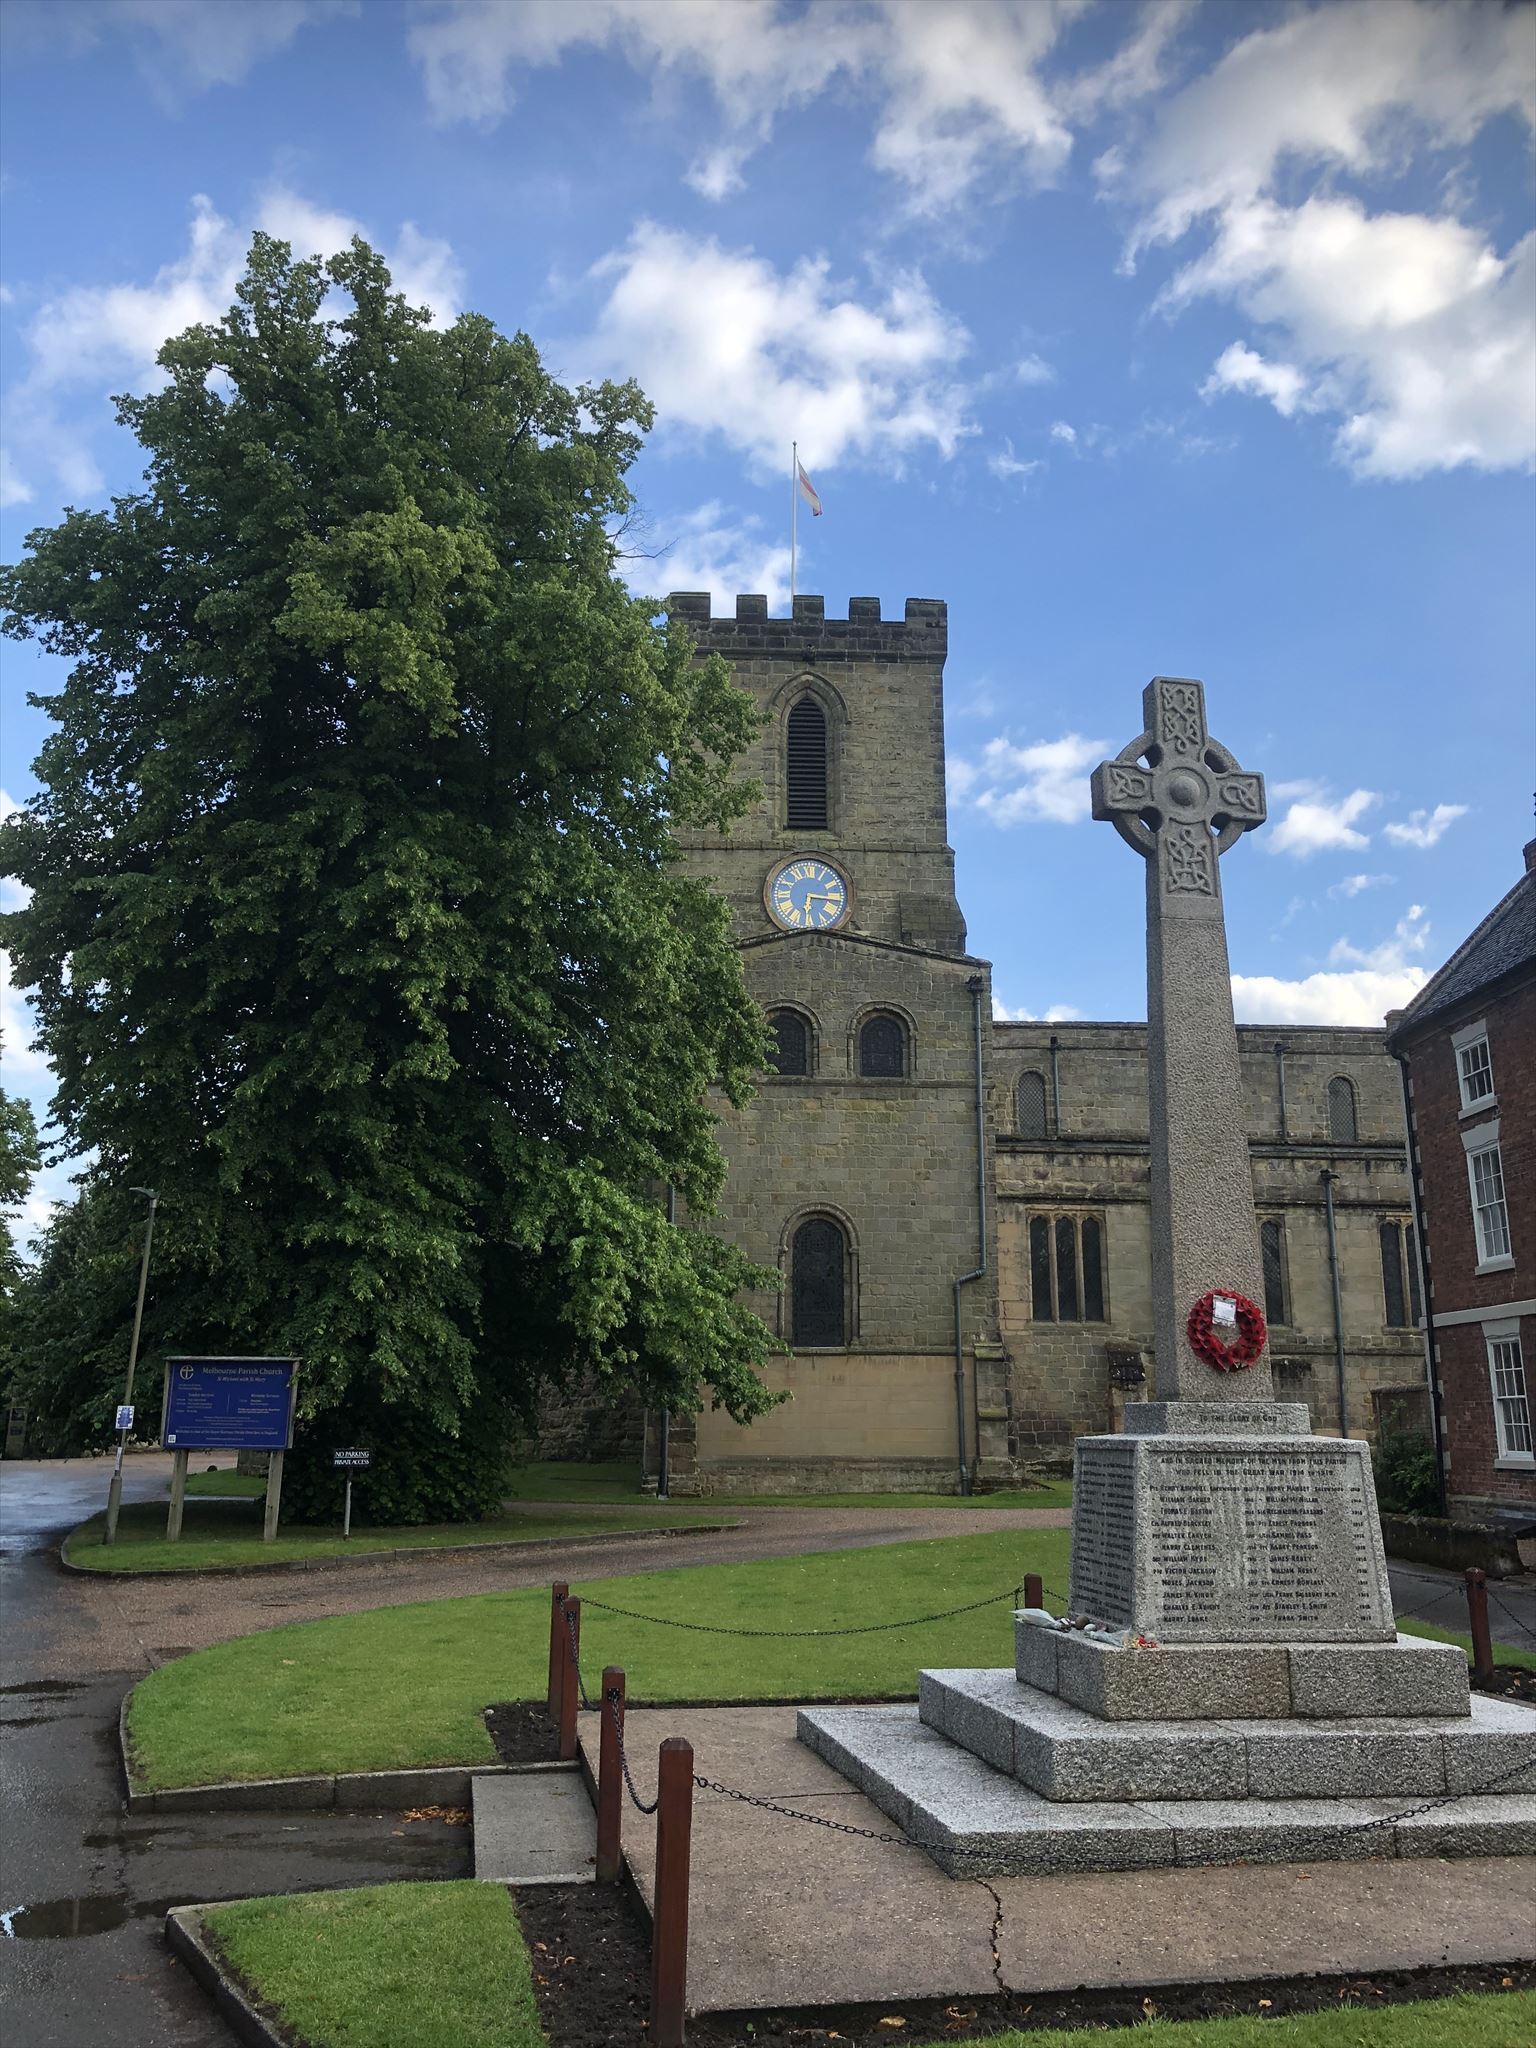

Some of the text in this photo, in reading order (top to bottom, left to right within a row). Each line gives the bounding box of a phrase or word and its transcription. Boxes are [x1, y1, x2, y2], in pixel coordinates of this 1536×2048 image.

[790, 868, 803, 882] XI
[804, 866, 815, 878] XII
[818, 870, 826, 880] I
[781, 879, 794, 888] X
[825, 880, 837, 890] II
[778, 890, 790, 898] IX
[780, 900, 793, 915] VIII
[789, 909, 800, 924] VII
[805, 914, 814, 926] VI
[818, 912, 827, 926] V
